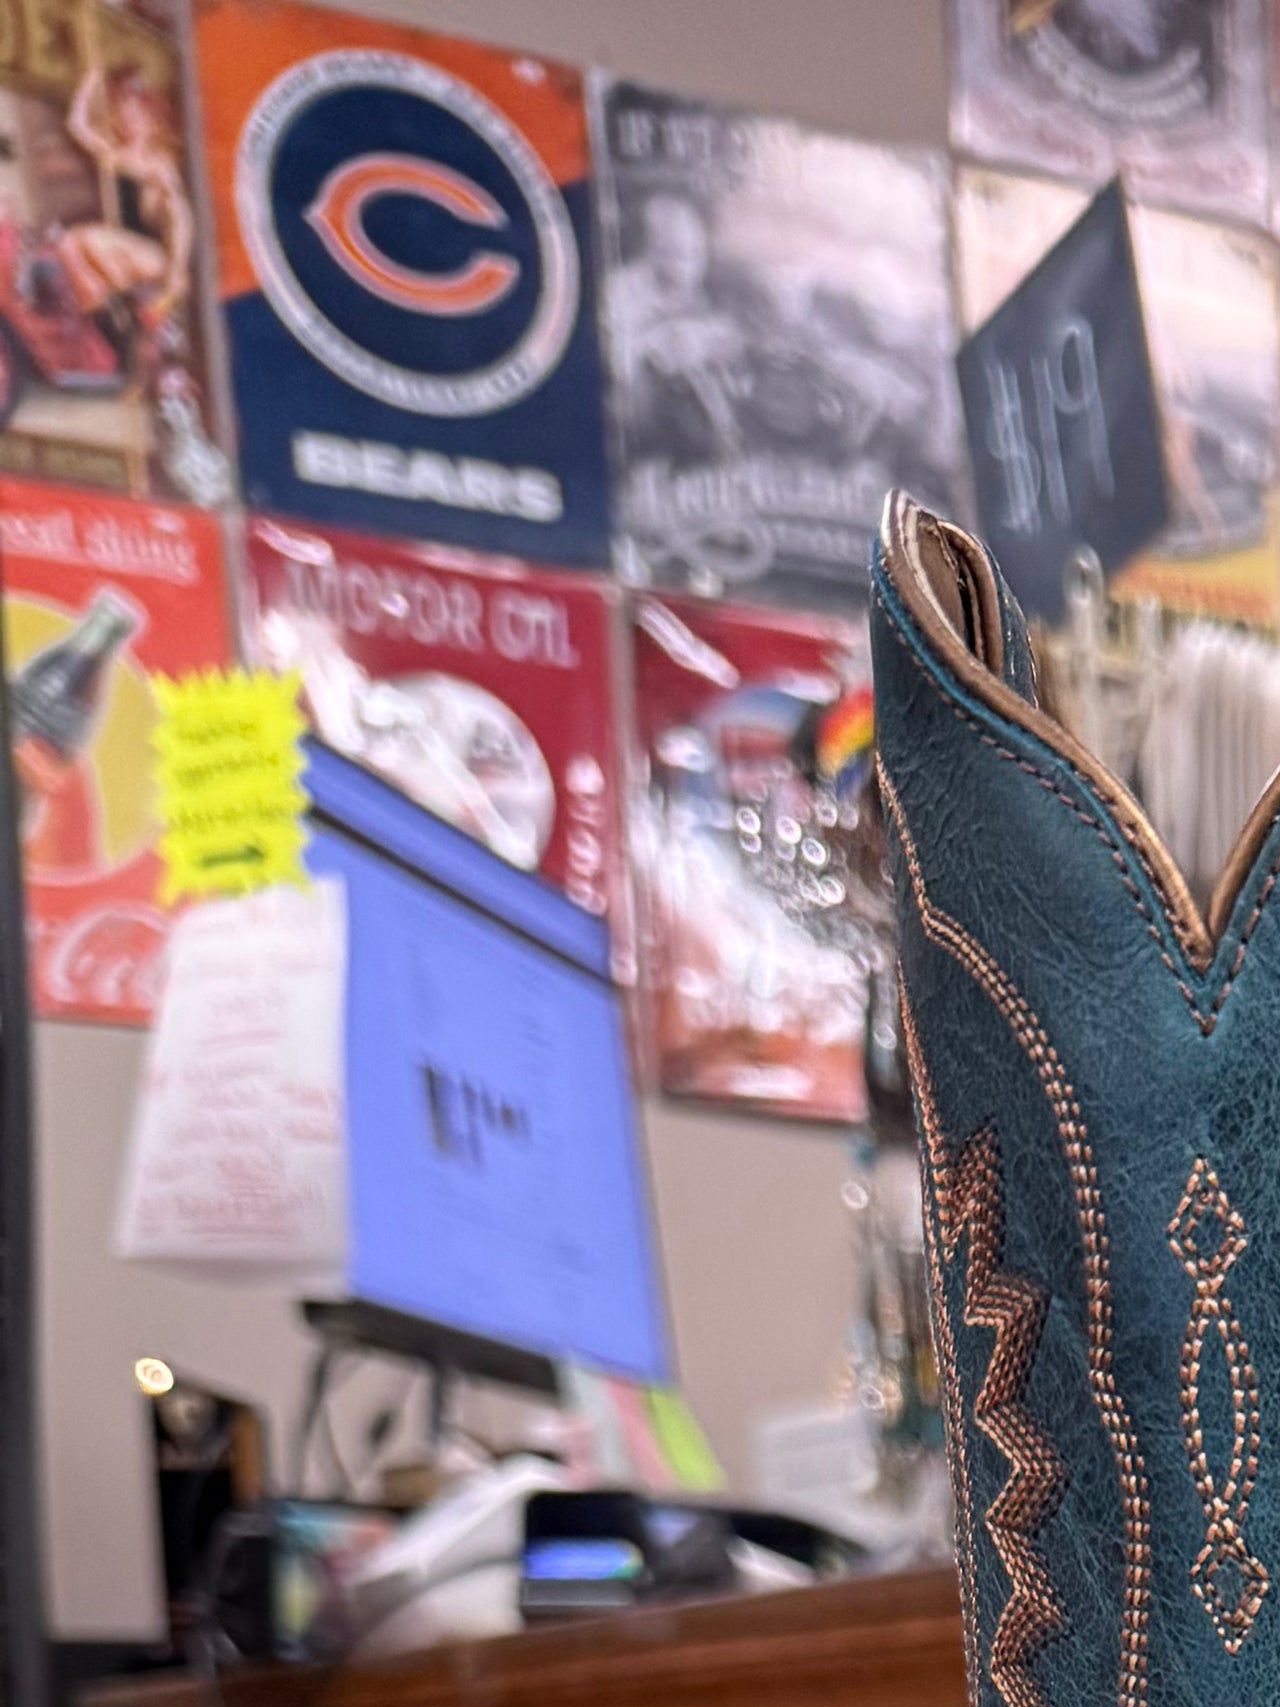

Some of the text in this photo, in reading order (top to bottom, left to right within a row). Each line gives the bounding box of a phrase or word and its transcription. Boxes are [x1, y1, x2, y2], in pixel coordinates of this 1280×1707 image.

[292, 429, 563, 524] BEARS
[285, 548, 583, 670] MOTOR OIL
